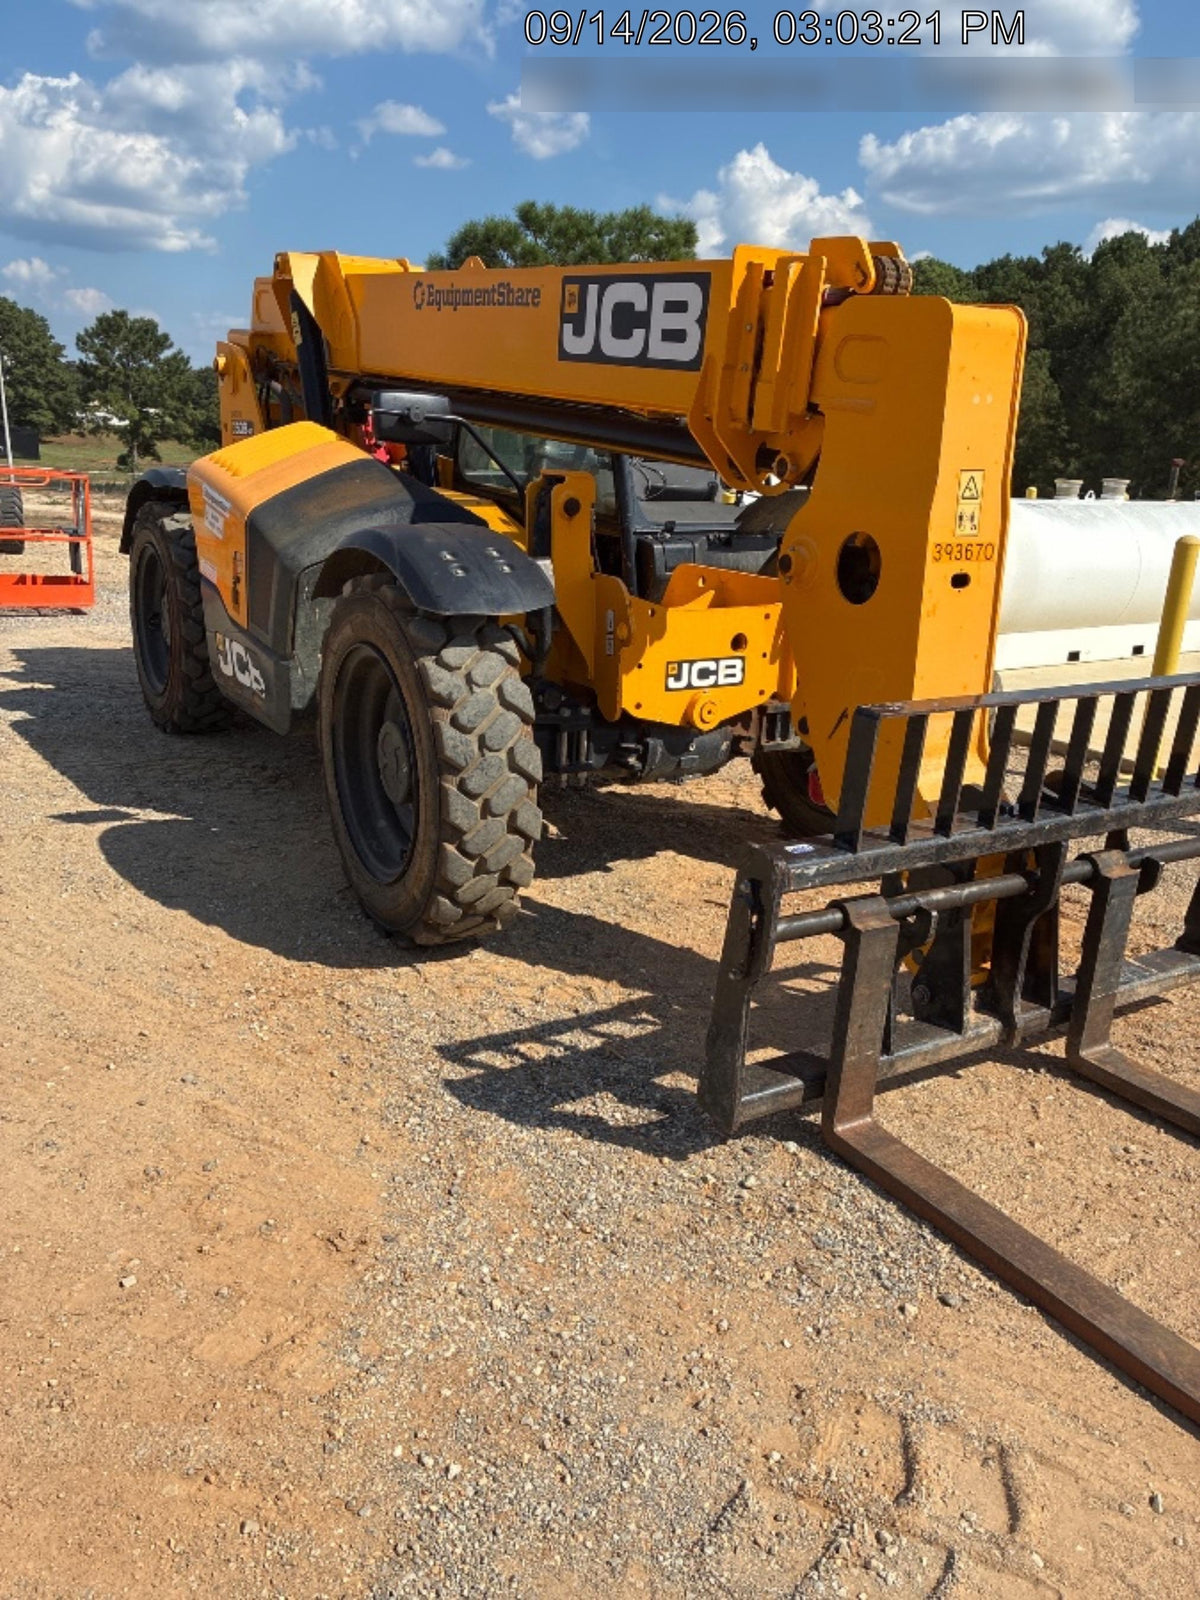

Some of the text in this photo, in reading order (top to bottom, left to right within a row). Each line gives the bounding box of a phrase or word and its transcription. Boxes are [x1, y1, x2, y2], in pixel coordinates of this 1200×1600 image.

[426, 281, 541, 311] EquipmentShare
[562, 281, 703, 361] JCB
[932, 543, 995, 562] 393670
[667, 658, 744, 689] JCB
